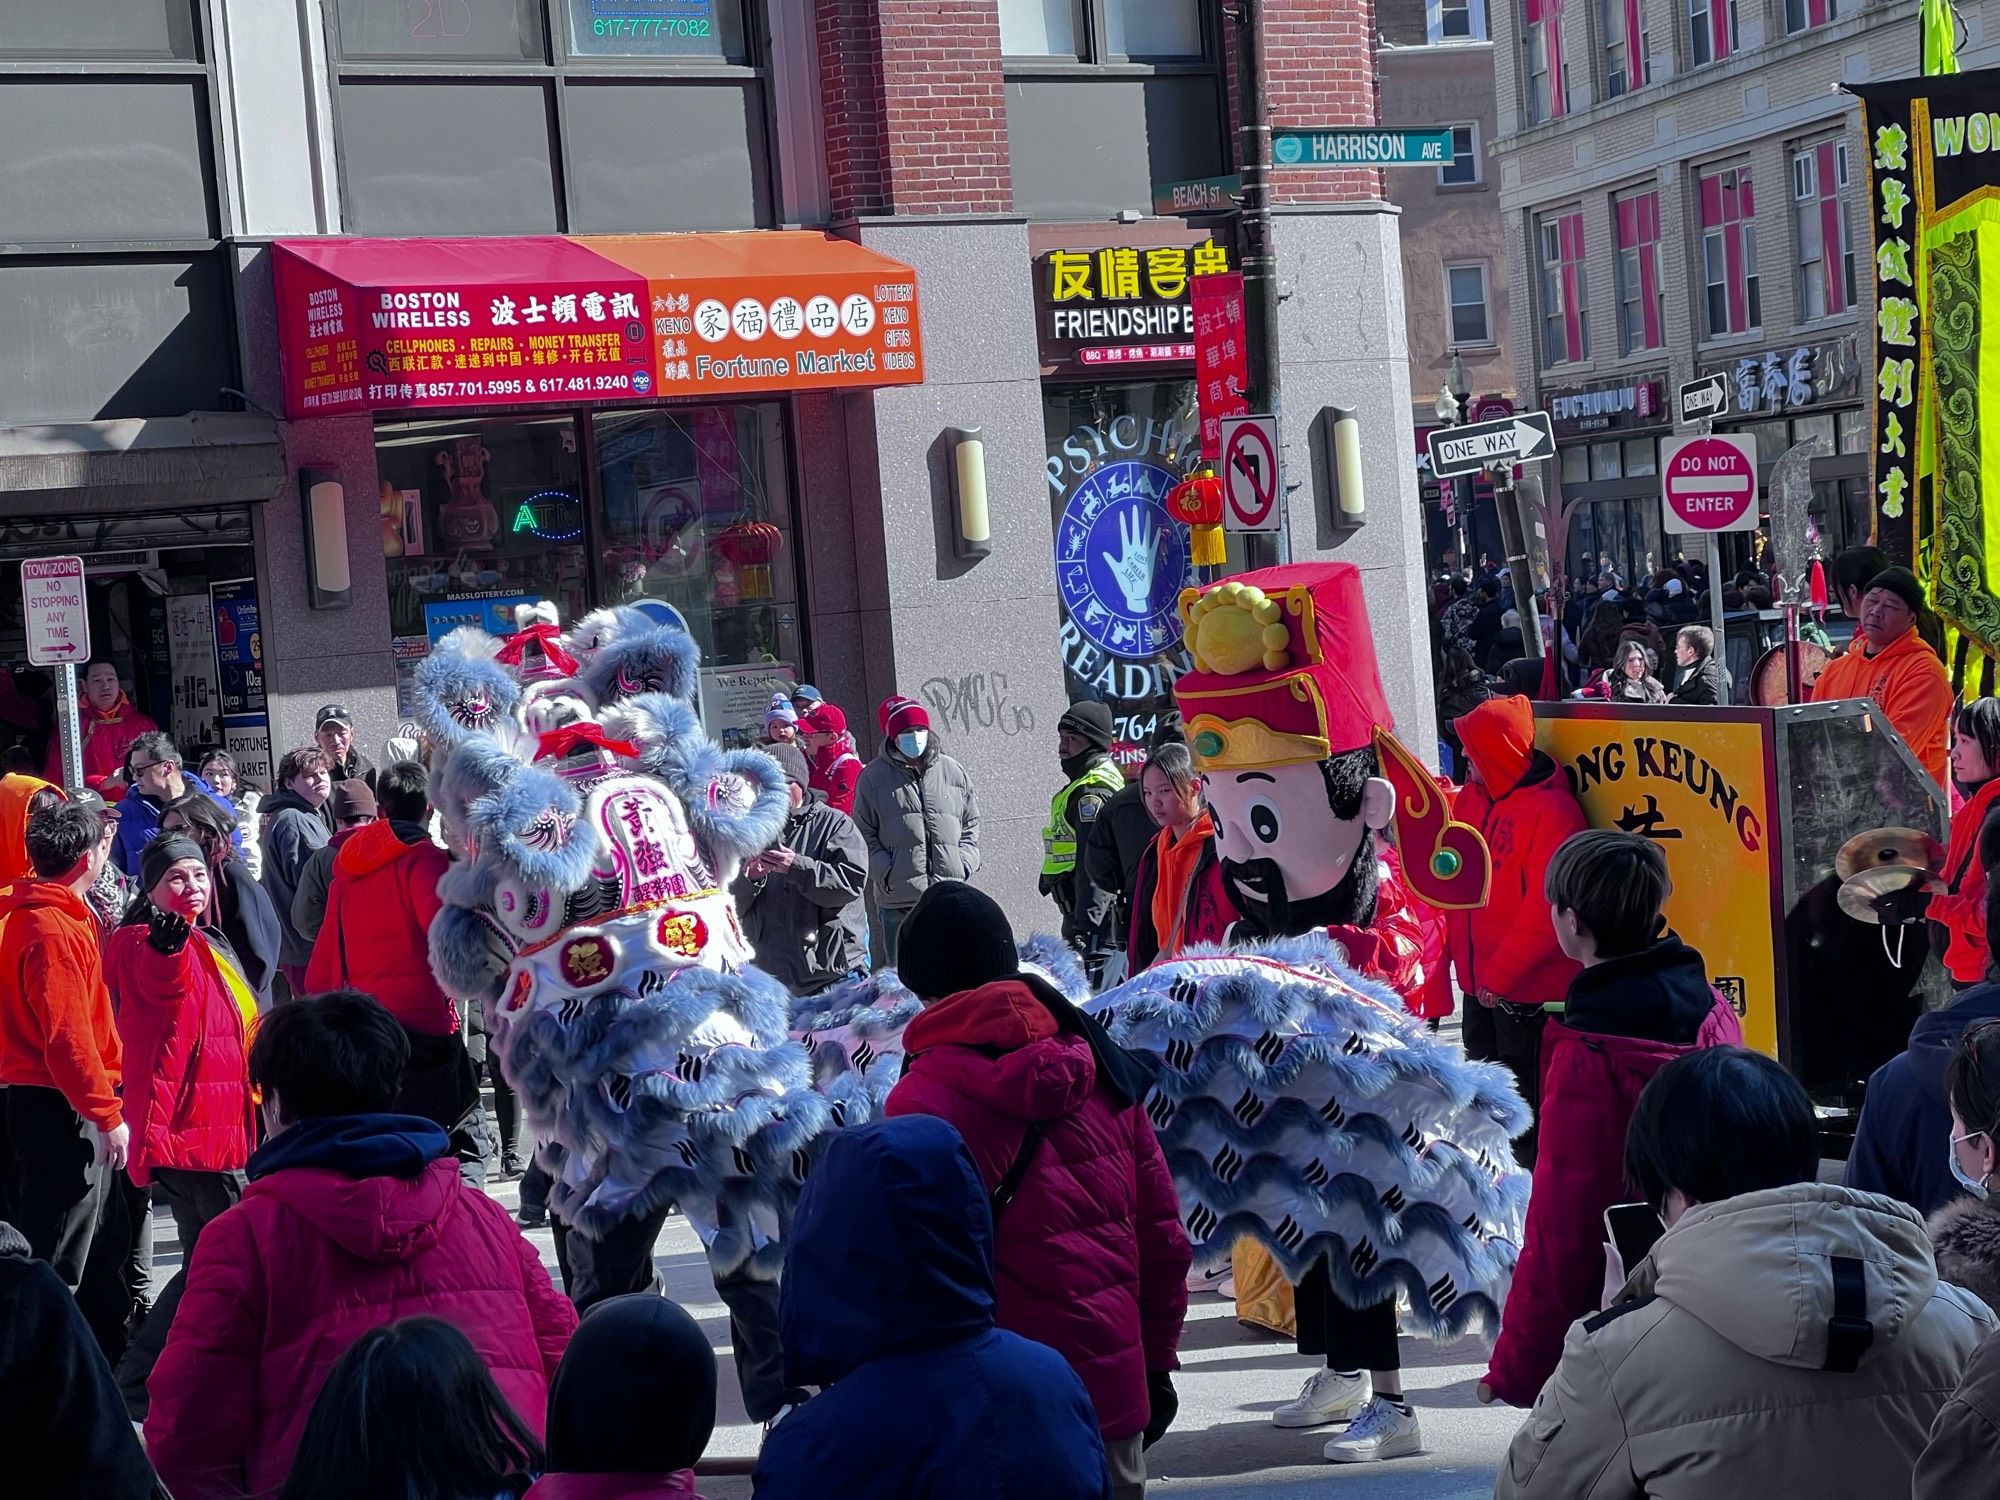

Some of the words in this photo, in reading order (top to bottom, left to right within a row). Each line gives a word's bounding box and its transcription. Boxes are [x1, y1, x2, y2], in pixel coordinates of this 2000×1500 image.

[594, 19, 710, 36] 617-777-7082
[1313, 133, 1405, 161] HARRISON
[1421, 142, 1442, 160] AVE
[1173, 184, 1207, 208] BEACH
[1209, 185, 1221, 204] ST
[308, 288, 338, 306] BOSTON
[381, 292, 460, 309] BOSTON
[874, 284, 914, 301] LOTTERY
[490, 291, 640, 326] 波士頓電訊
[653, 293, 690, 313] 六合彩
[307, 303, 343, 321] WIRELESS
[372, 311, 471, 328] WIRELESS
[699, 297, 870, 339] 家福禮品店
[884, 307, 908, 324] KENO
[1197, 299, 1241, 336] 波士頓
[655, 317, 691, 335] KENO
[1055, 305, 1180, 338] FRIENDSHIP
[386, 338, 456, 354] CELLPHONES
[470, 336, 514, 351] REPAIRS
[529, 335, 565, 349] MONEY
[568, 333, 621, 347] TRANSFER
[885, 329, 911, 347] GIFTS
[696, 355, 789, 379] Fortune
[796, 348, 875, 375] Market
[883, 352, 915, 370] VIDEOS
[1086, 351, 1101, 360] BBQ
[429, 380, 522, 397] 857.701.5995
[525, 379, 536, 393] &
[539, 375, 628, 392] 617.481.9240
[632, 376, 650, 386] vigo
[1686, 393, 1698, 409] ONE
[1701, 388, 1713, 405] WAY
[1444, 439, 1476, 460] ONE
[1484, 431, 1516, 452] WAY
[1680, 457, 1702, 472] DO
[1707, 456, 1736, 471] NOT
[1686, 497, 1734, 512] ENTER
[513, 503, 580, 532] ATM
[25, 563, 48, 576] TOW
[52, 561, 79, 574] ZONE
[46, 581, 61, 592] NO
[446, 588, 525, 601] MASSLOTTERY.COM
[31, 595, 79, 608] STOPPING
[46, 611, 66, 623] ANY
[46, 627, 69, 638] TIME
[220, 649, 240, 661] CHINA
[717, 677, 736, 687] We
[739, 673, 776, 688] Repair
[223, 694, 239, 707] Lyca
[229, 736, 268, 752] FORTUNE
[1633, 737, 1761, 852] KEUNG
